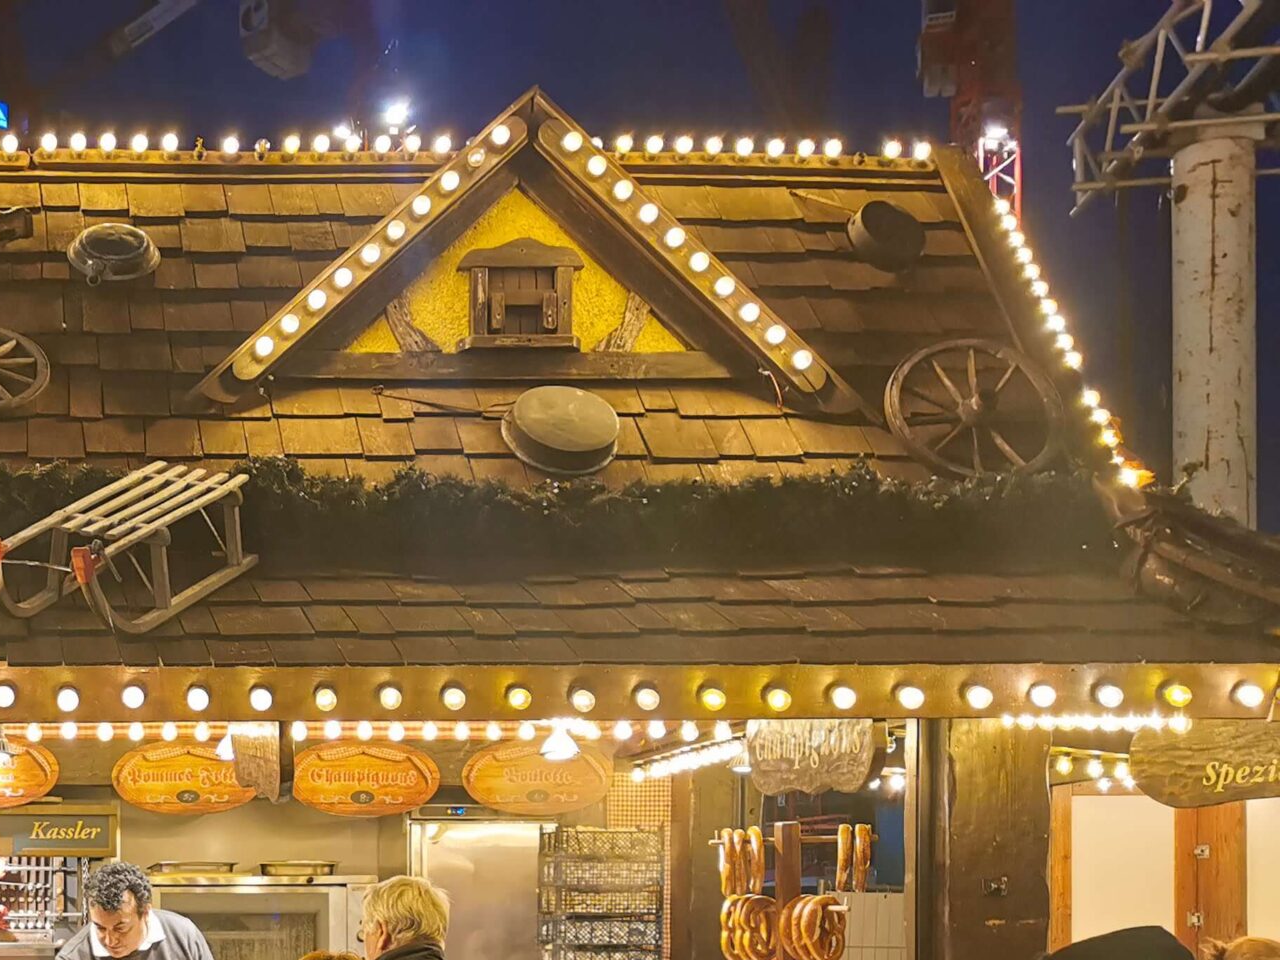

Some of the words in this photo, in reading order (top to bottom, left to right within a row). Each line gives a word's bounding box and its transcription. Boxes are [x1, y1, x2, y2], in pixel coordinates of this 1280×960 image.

[127, 767, 194, 787] Pommes
[308, 766, 418, 789] Champignons
[29, 820, 101, 840] Kassler
